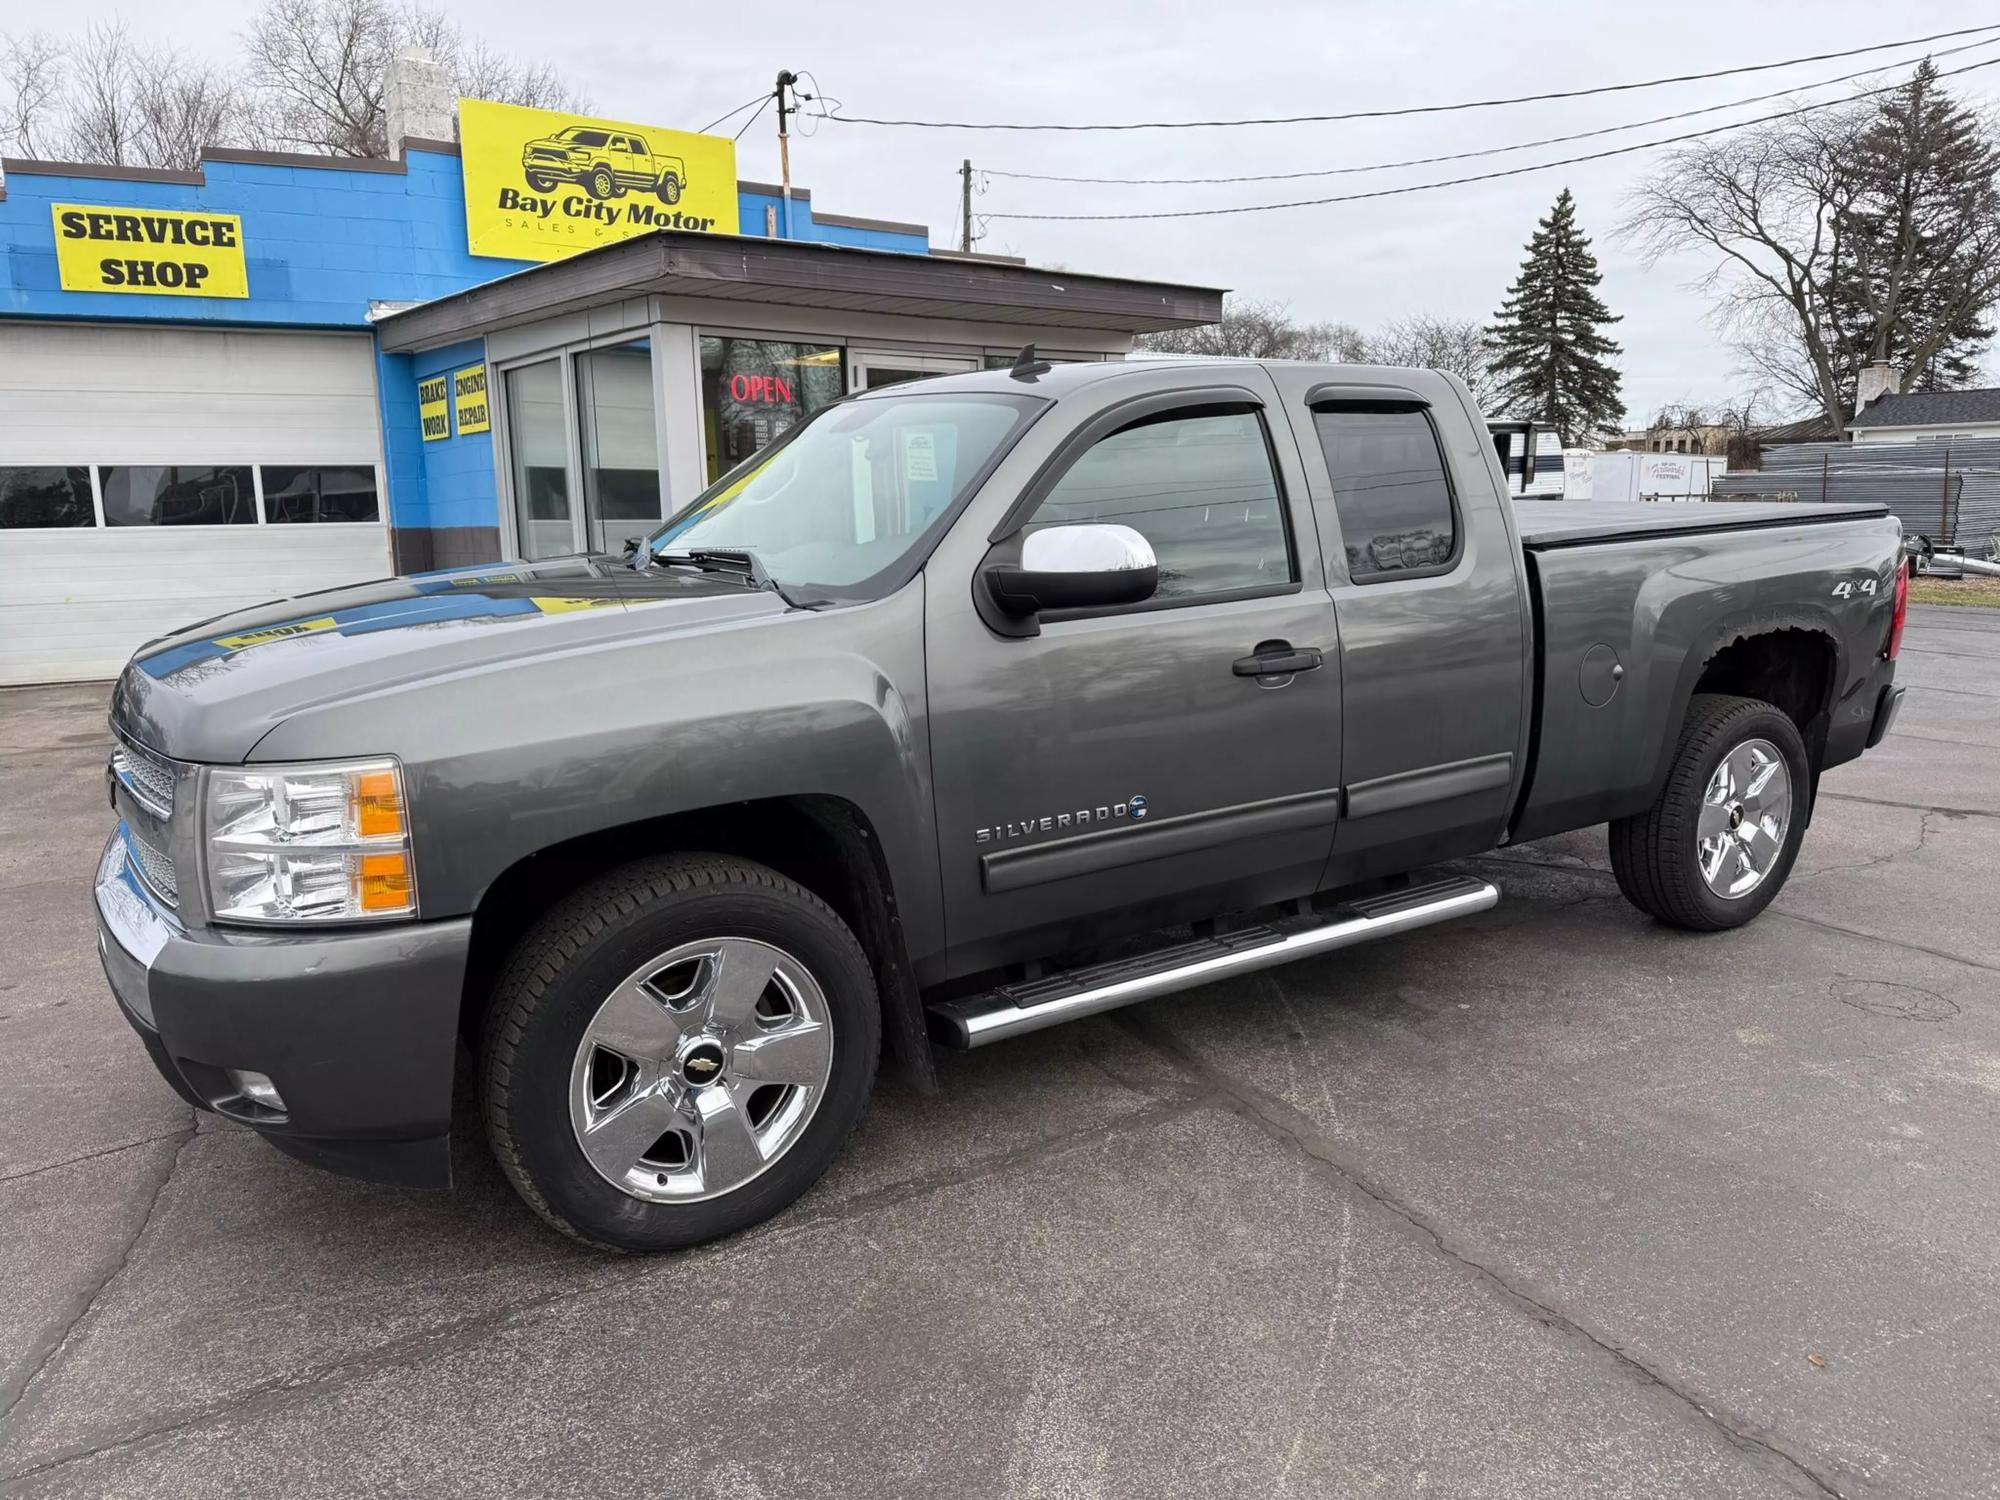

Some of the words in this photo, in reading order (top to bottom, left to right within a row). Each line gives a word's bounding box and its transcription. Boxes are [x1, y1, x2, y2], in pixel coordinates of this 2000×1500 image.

[498, 187, 557, 219] Bay
[562, 195, 622, 226] City
[626, 203, 716, 232] Motor
[61, 211, 236, 248] SERVICE
[505, 218, 575, 234] SALES
[594, 227, 604, 237] &
[100, 258, 209, 289] SHOP
[419, 380, 446, 405] BRAKE
[455, 372, 485, 397] ENGINE
[730, 374, 792, 404] OPEN
[422, 414, 447, 437] WORK
[458, 404, 487, 427] REPAIR
[975, 803, 1127, 843] SILVERADO
